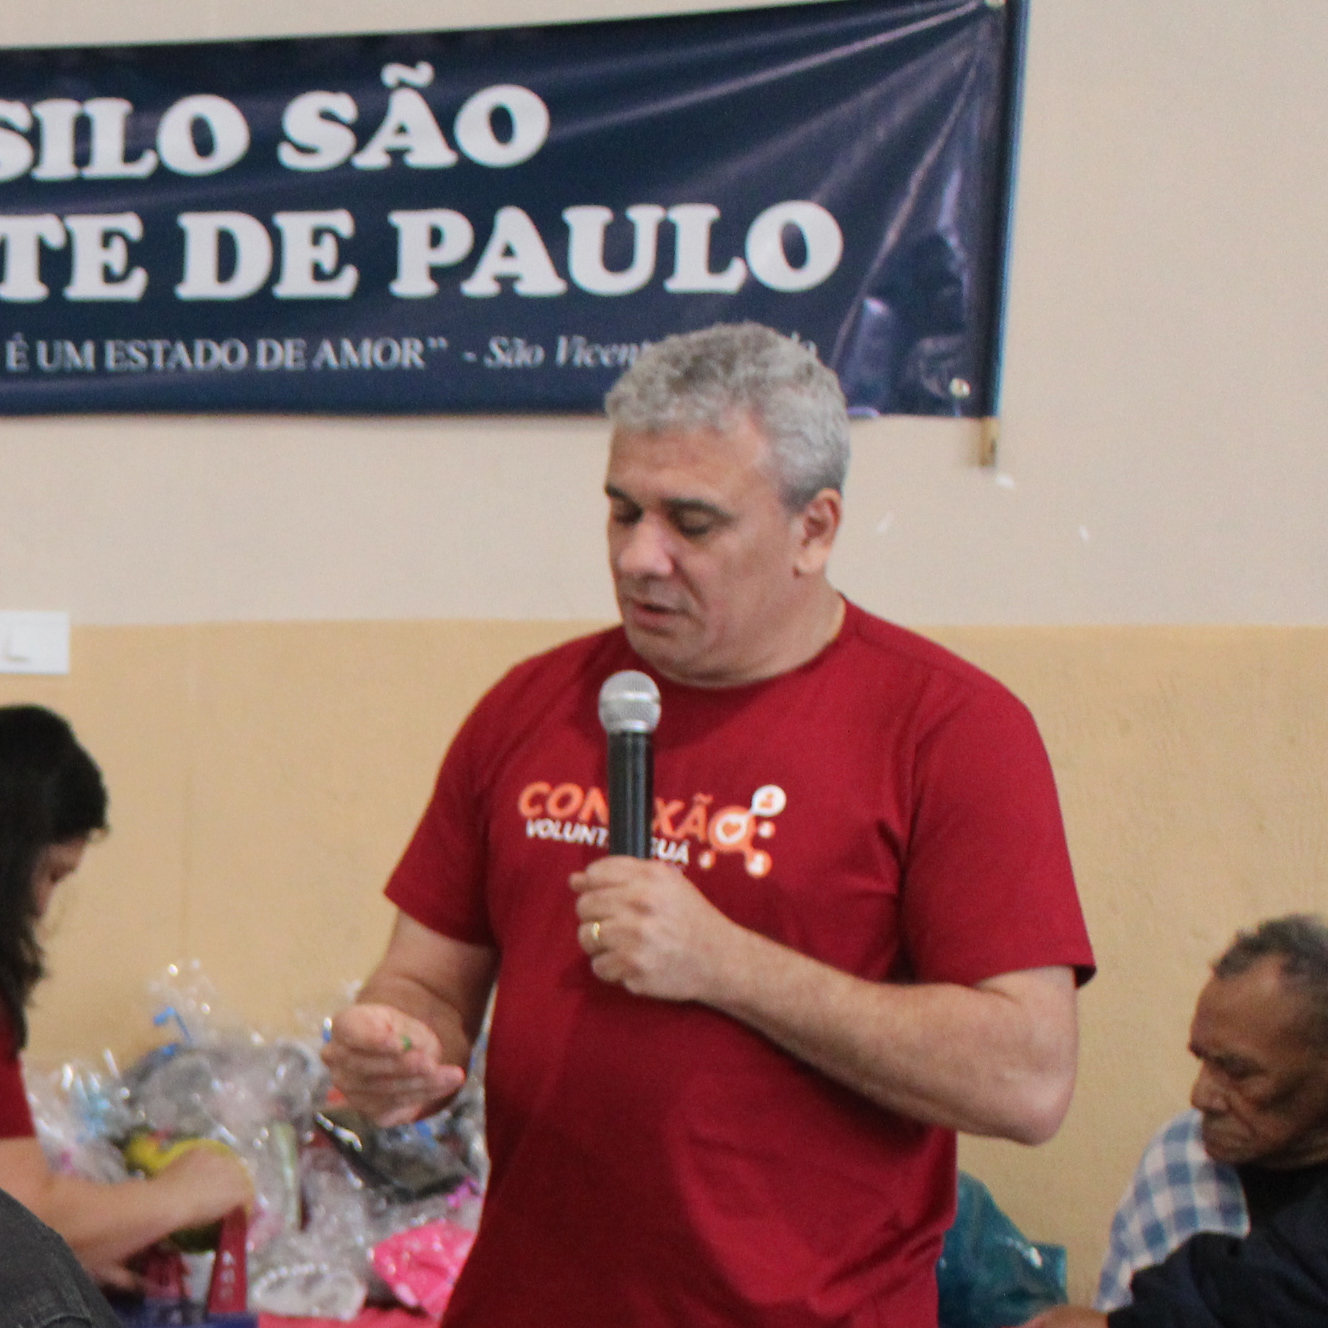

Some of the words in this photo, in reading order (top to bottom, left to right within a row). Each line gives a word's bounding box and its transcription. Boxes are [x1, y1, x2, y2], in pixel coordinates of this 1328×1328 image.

[277, 62, 550, 172] SÃO
[175, 209, 358, 300] DE
[387, 200, 844, 298] PAULO
[5, 332, 30, 371] É
[36, 338, 96, 371] UM
[104, 338, 250, 371] ESTADO
[256, 338, 308, 370] DE
[484, 335, 544, 369] São
[555, 335, 644, 368] Vicen
